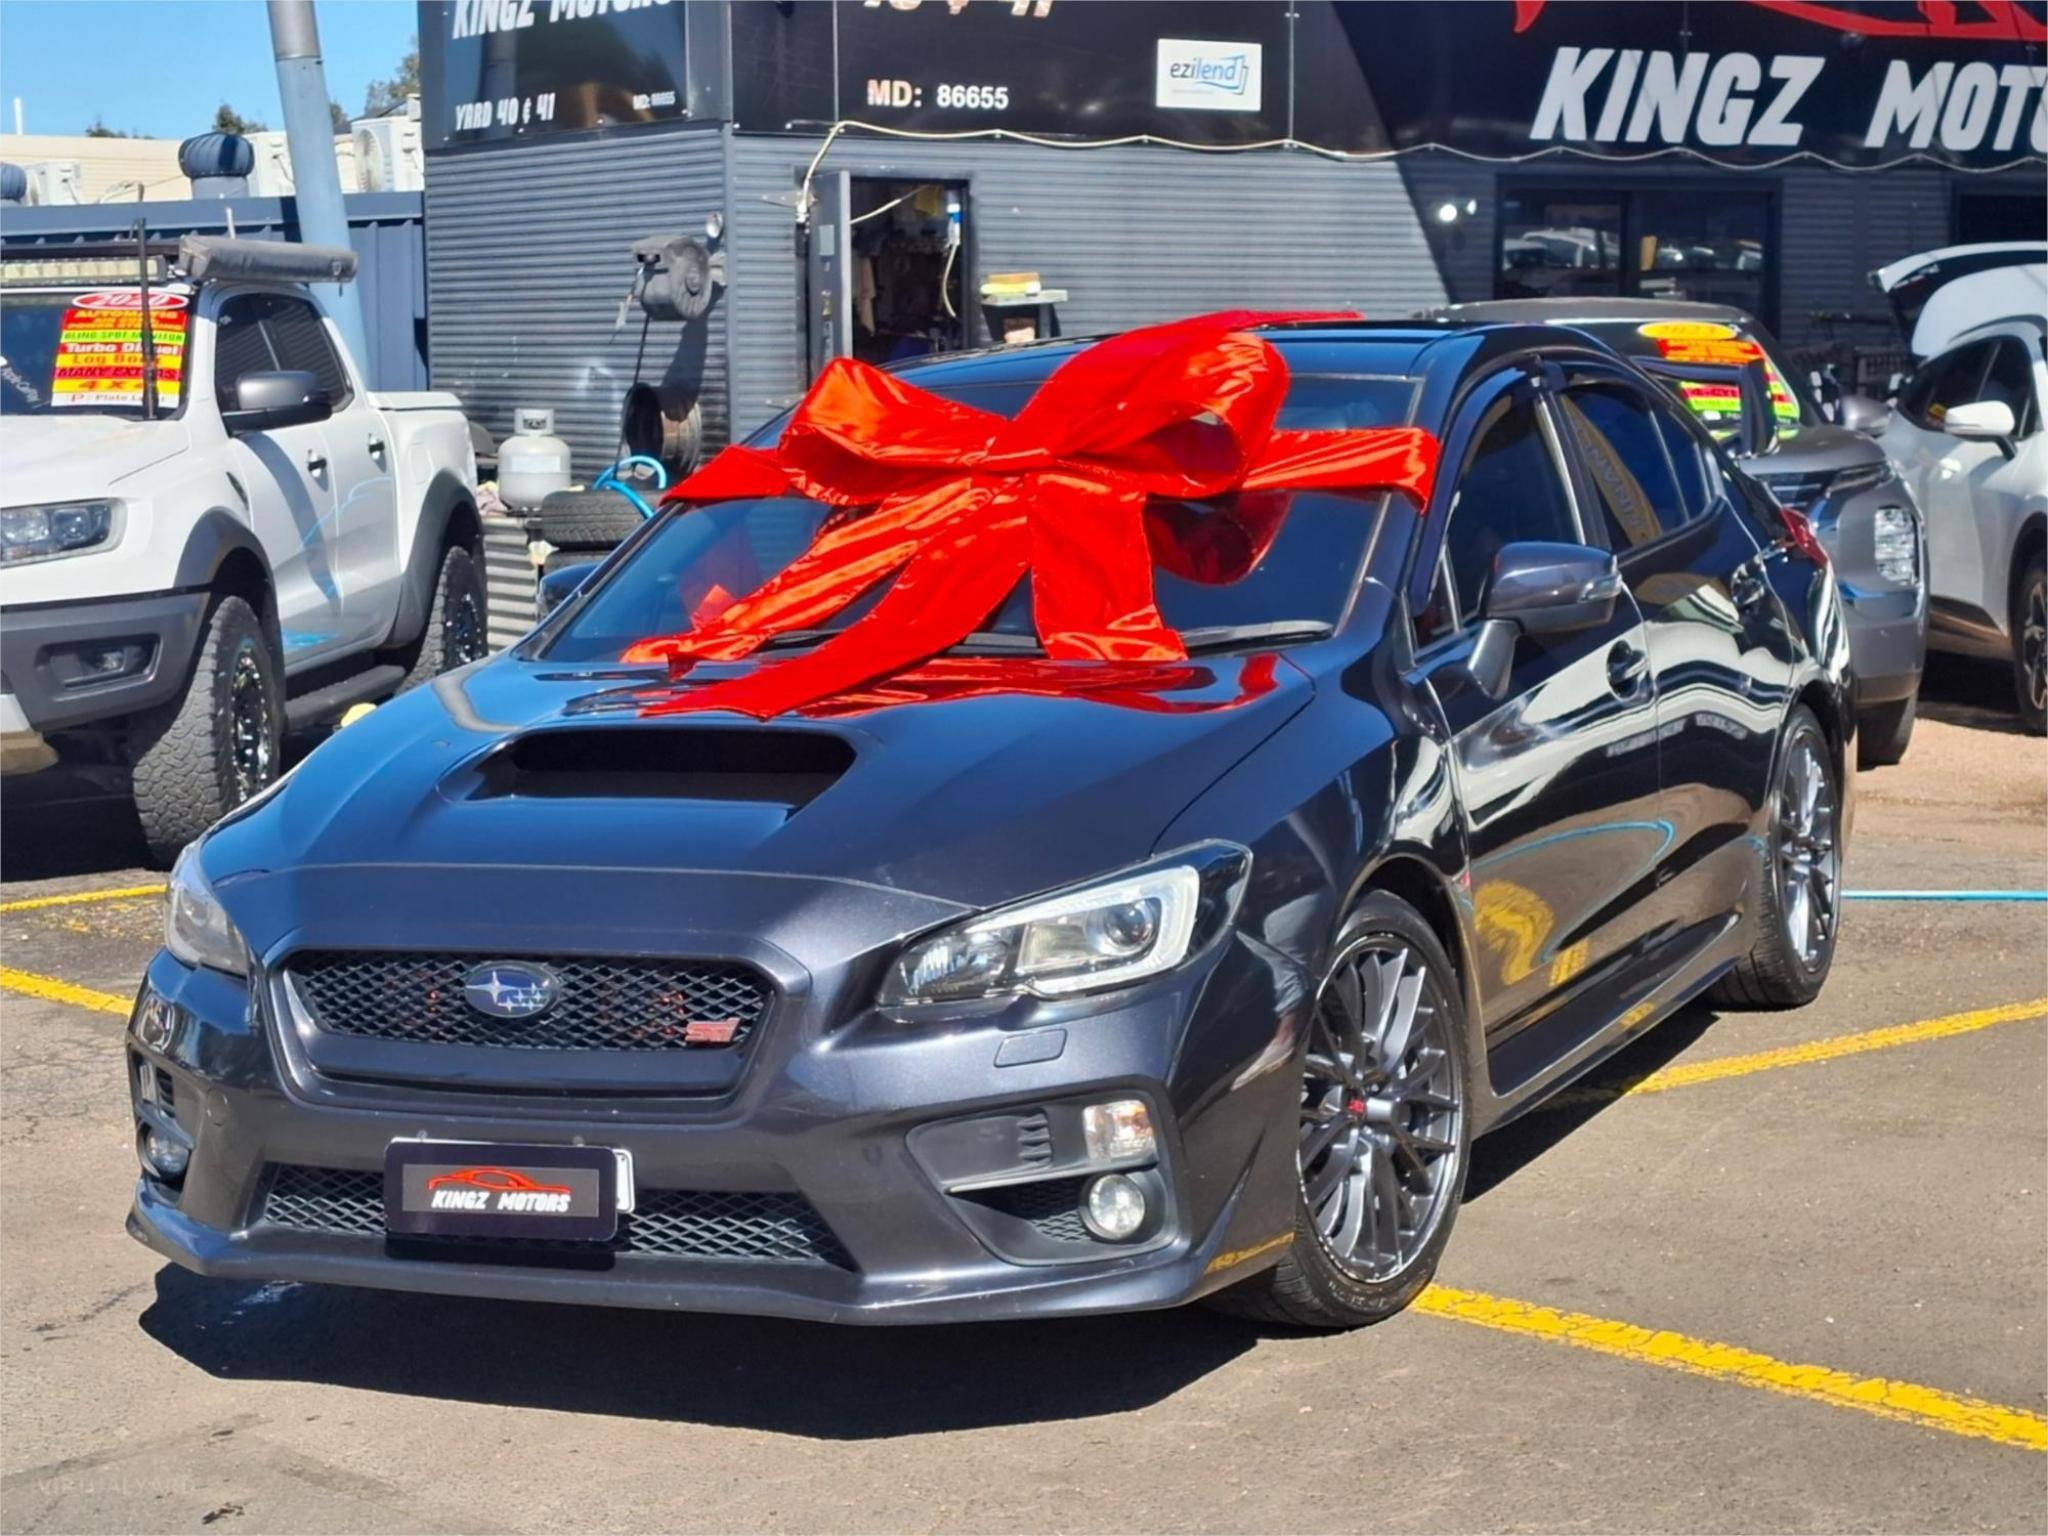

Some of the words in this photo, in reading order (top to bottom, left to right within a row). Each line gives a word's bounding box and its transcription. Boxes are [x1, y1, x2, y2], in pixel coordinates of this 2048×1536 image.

[1170, 57, 1237, 80] ezilend
[867, 79, 922, 107] MD:
[937, 84, 1009, 109] 86655
[1530, 46, 1825, 146] KINGZ
[1864, 59, 2047, 153] MOT
[456, 101, 493, 131] YARD
[496, 97, 519, 126] 40
[536, 92, 556, 121] 41
[66, 342, 117, 353] Turbo
[431, 1190, 489, 1210] KINGZ
[497, 1192, 571, 1213] MOTORS
